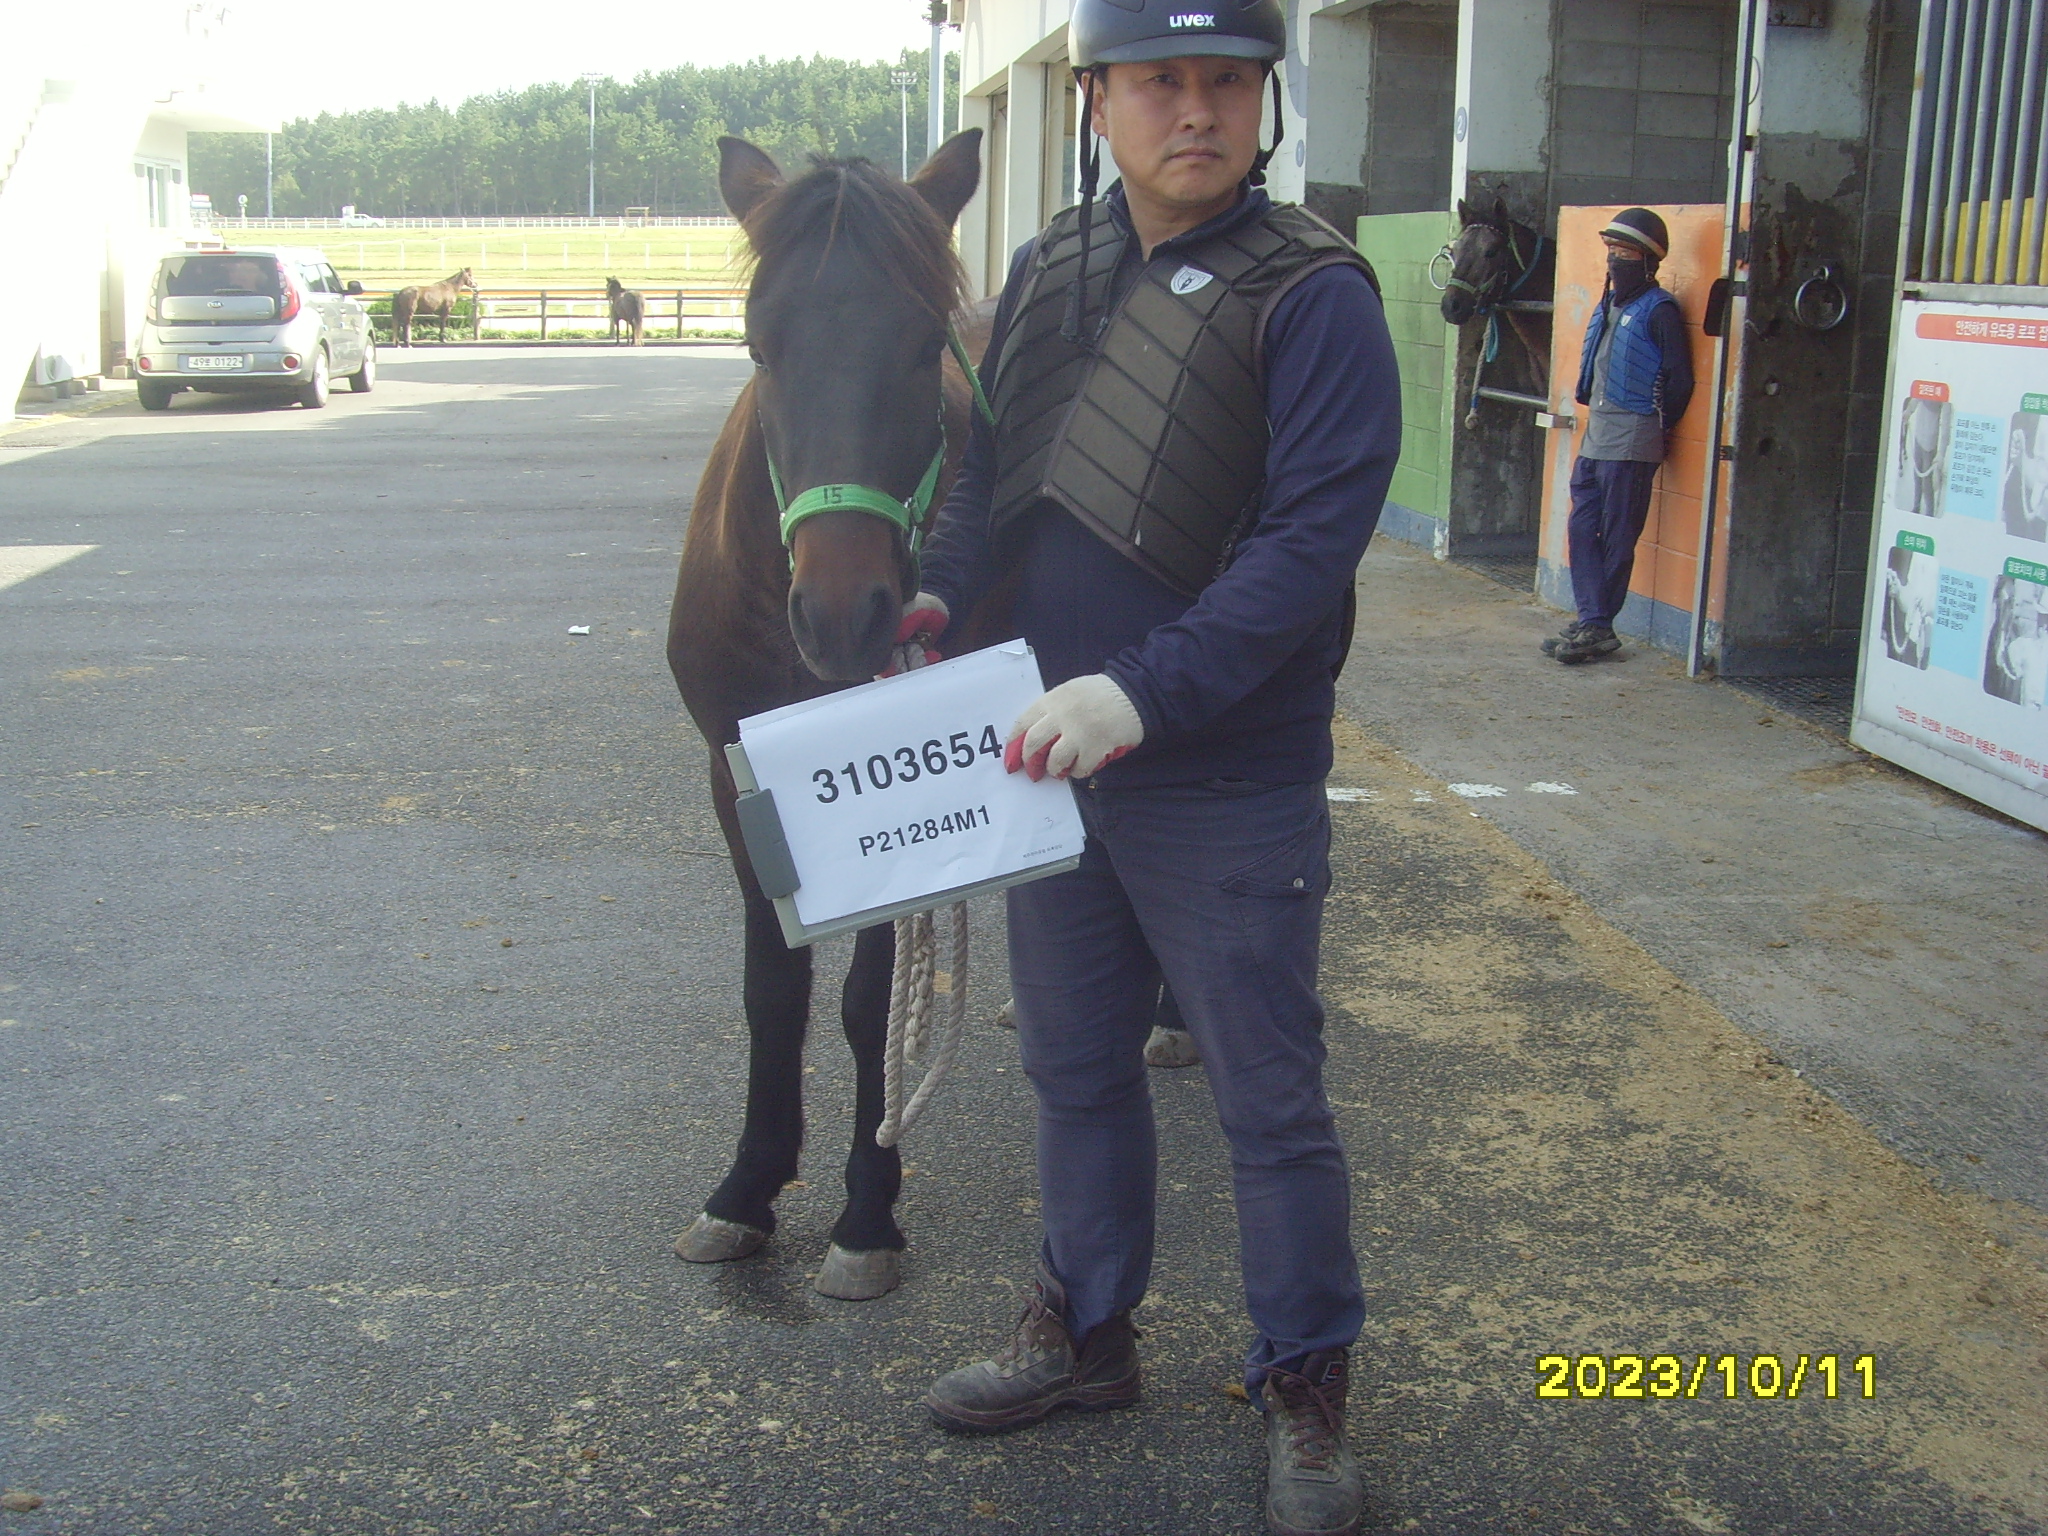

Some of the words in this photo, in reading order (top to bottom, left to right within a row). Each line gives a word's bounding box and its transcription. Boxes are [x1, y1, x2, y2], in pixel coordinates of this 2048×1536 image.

[1169, 14, 1216, 28] uvex
[1456, 115, 1463, 135] 2
[1955, 320, 1989, 338] 안전하게
[1990, 322, 2016, 340] 유도용
[2017, 324, 2036, 340] 로프
[214, 357, 238, 367] 0122
[823, 486, 844, 505] 15
[812, 724, 1003, 804] 3103654
[1975, 737, 1997, 758] 착용은
[1998, 747, 2022, 769] 선택이
[2024, 757, 2041, 775] 아닌
[858, 804, 990, 857] P21284M1
